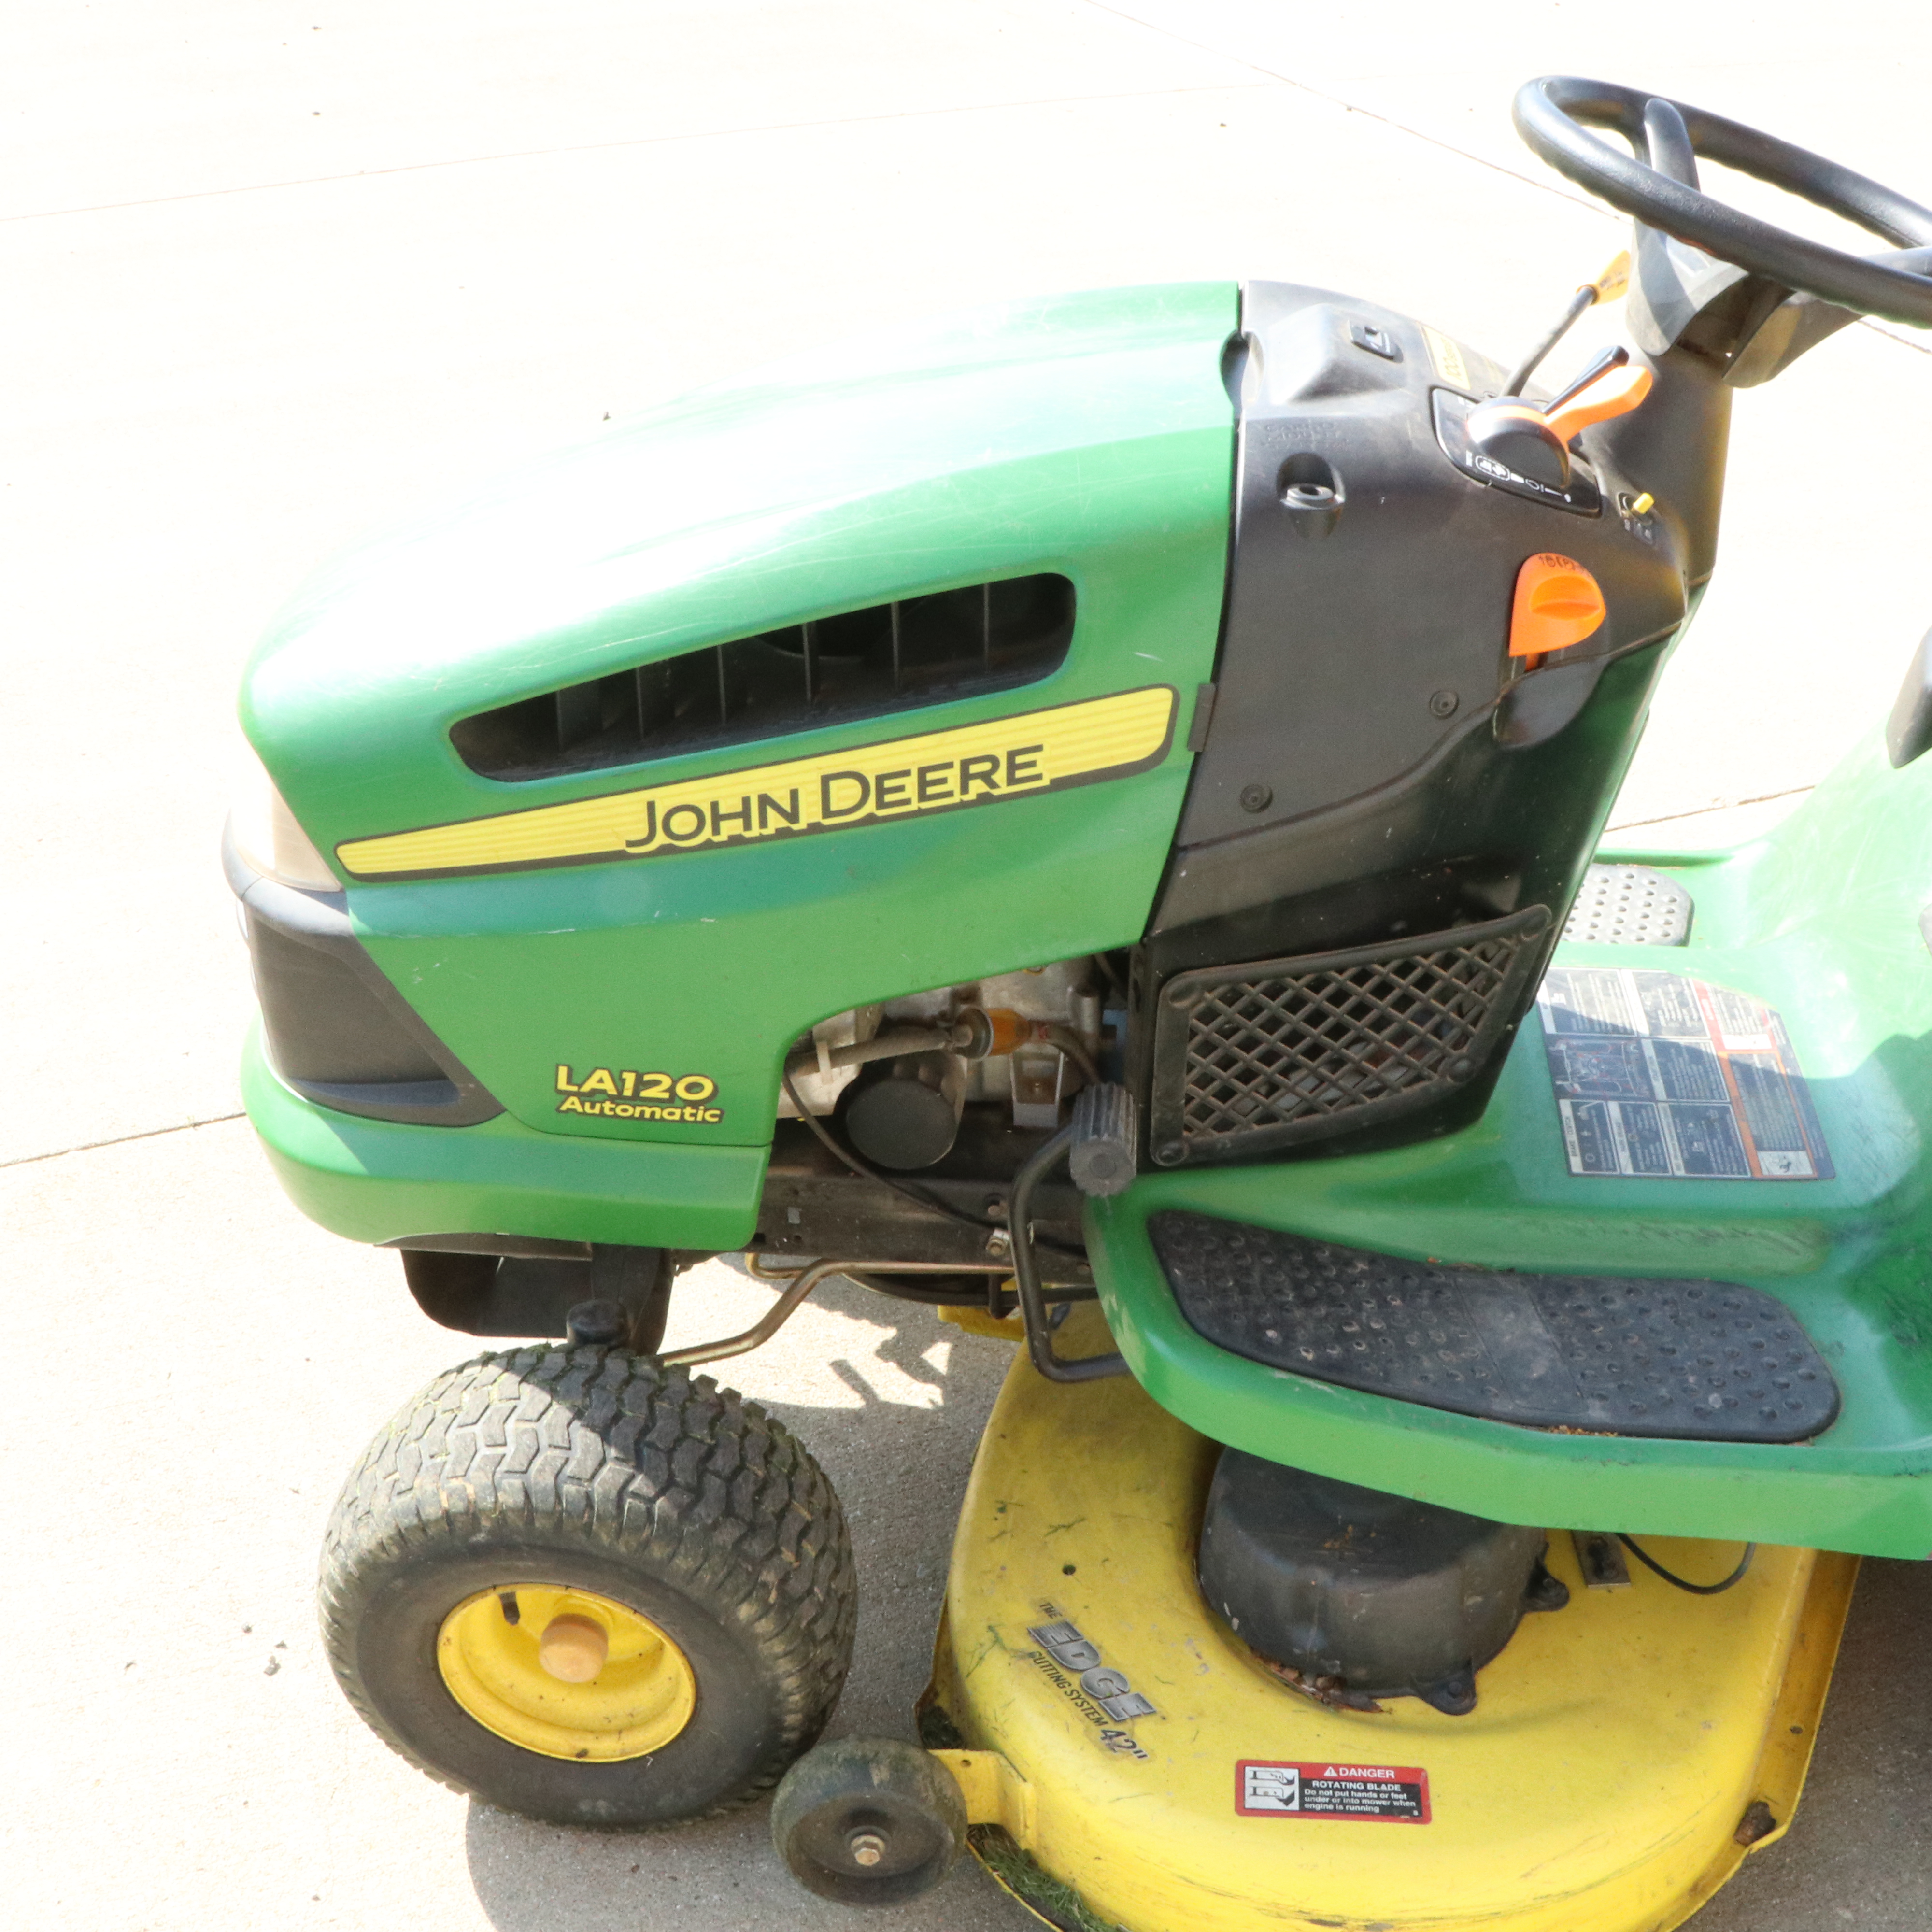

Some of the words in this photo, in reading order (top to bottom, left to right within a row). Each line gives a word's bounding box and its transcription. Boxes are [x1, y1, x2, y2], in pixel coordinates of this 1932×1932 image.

[625, 787, 800, 849] JOHN
[820, 744, 1045, 820] DEERE
[556, 1065, 717, 1103] LA120
[558, 1095, 722, 1122] Automatic
[1039, 1602, 1063, 1619] THE
[1026, 1619, 1157, 1722] EDGE
[1033, 1650, 1072, 1690] CUTTING
[1064, 1688, 1109, 1727] SYSTEM
[1100, 1729, 1148, 1759] 42"
[1312, 1780, 1364, 1790] ROTATING
[1366, 1782, 1401, 1792] BLADE
[1339, 1767, 1395, 1778] DANGER
[1346, 1804, 1379, 1813] running
